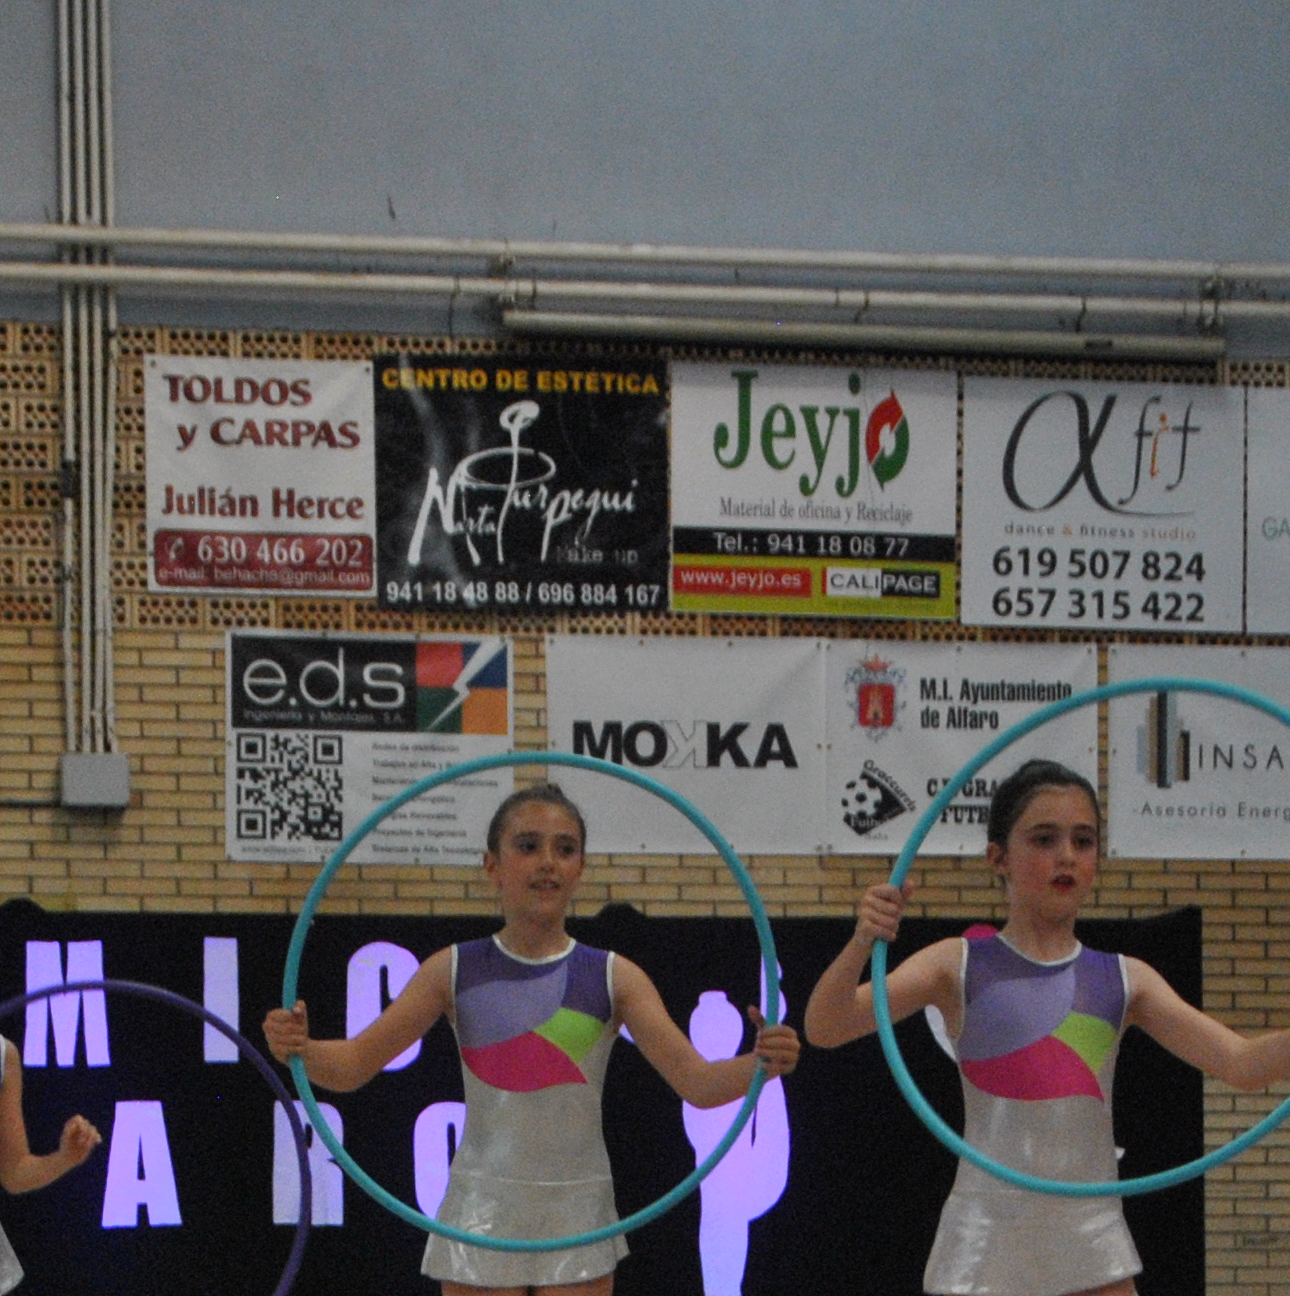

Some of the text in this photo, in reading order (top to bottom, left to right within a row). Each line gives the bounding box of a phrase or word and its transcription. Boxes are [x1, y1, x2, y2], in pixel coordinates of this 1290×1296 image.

[162, 373, 313, 407] TOLDOS
[382, 368, 488, 391] CENTRO
[495, 370, 530, 392] DE
[176, 416, 361, 452] y CARPAS
[161, 484, 365, 519] Julián Herce
[718, 497, 775, 517] Material
[779, 499, 794, 517] de
[799, 499, 842, 519] oficina
[843, 506, 852, 524] y
[1004, 521, 1197, 541] dance & fitness studio
[197, 535, 364, 567] 630 466 202
[767, 533, 806, 552] 941
[818, 535, 841, 554] 18
[849, 536, 876, 555] 08
[884, 538, 909, 557] 77
[992, 545, 1206, 582] 619 507 824
[680, 568, 802, 588] www.jeyjo.es
[386, 580, 423, 601] 941
[432, 581, 457, 602] 18
[463, 581, 489, 602] 48
[495, 582, 521, 602] 88
[538, 582, 576, 604] 696
[580, 583, 618, 605] 884
[625, 584, 661, 606] 167
[992, 587, 1205, 623] 657 315 422
[960, 679, 1072, 705] Ayuntamiento
[920, 705, 1000, 730] de Alfaro
